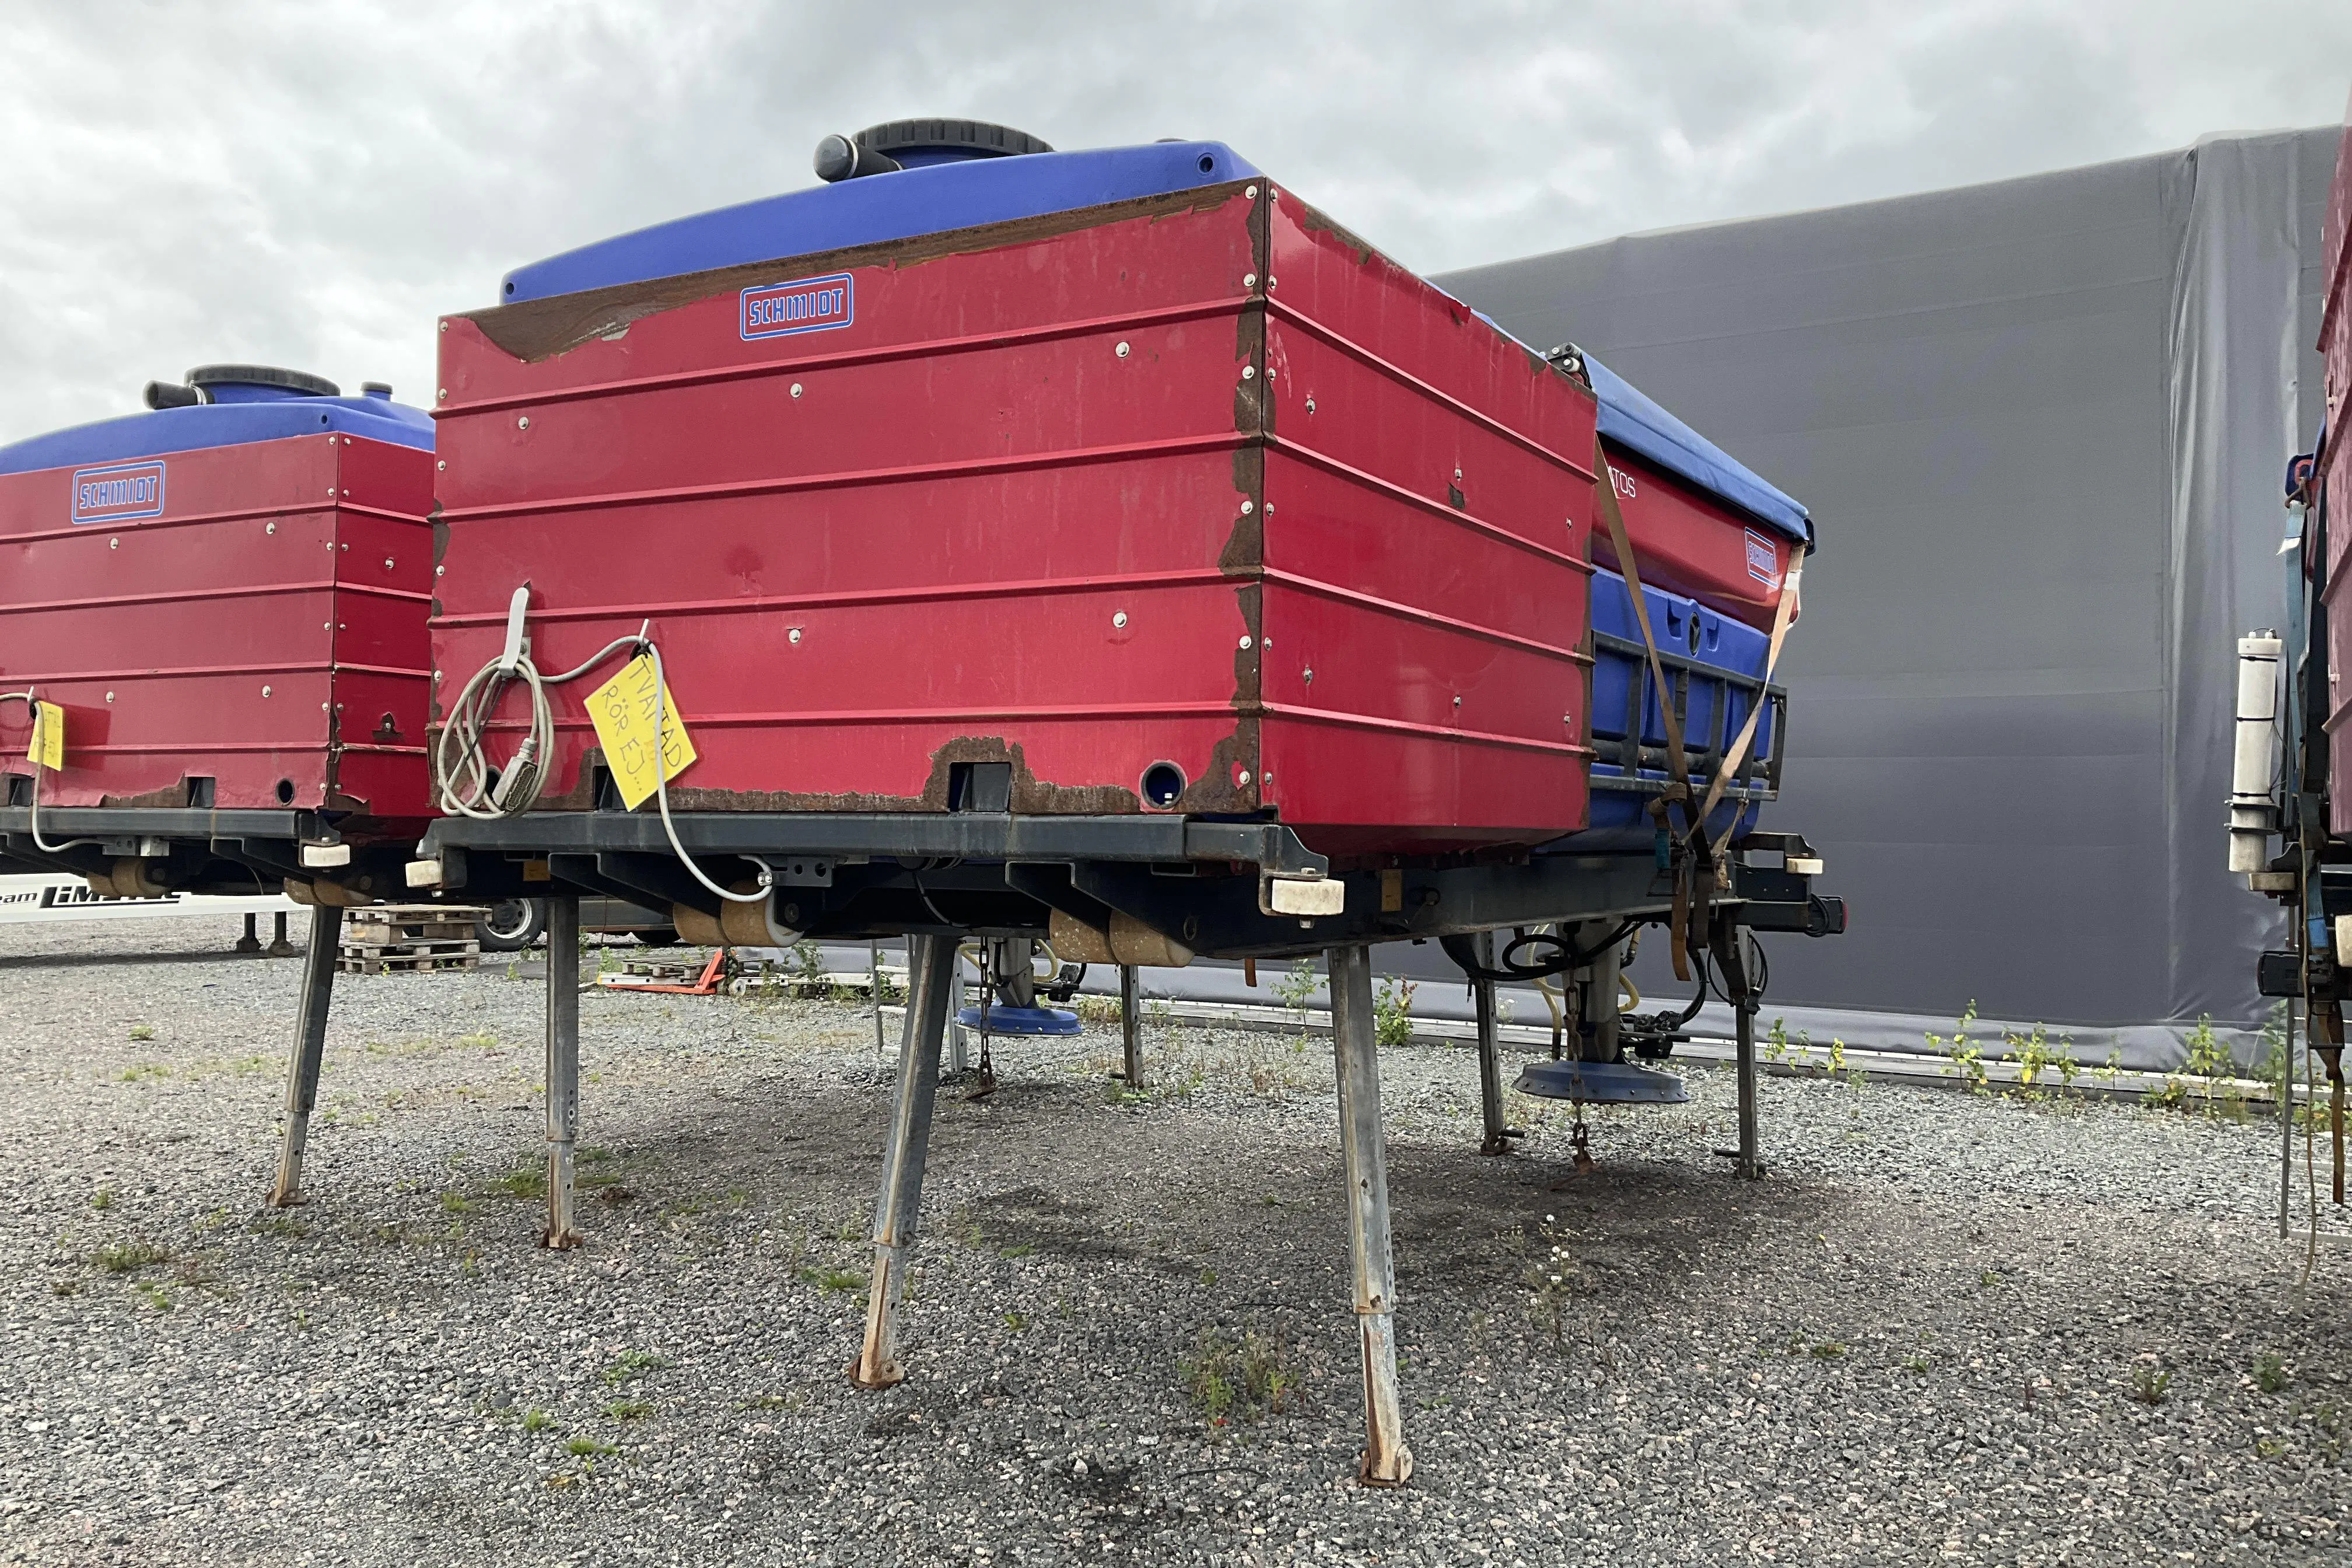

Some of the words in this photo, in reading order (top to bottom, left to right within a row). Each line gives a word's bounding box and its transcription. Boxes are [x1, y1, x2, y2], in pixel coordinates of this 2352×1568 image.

[750, 288, 844, 326] SCHMIDT
[79, 476, 157, 509] SCHMIDT
[601, 685, 628, 737] RÖR
